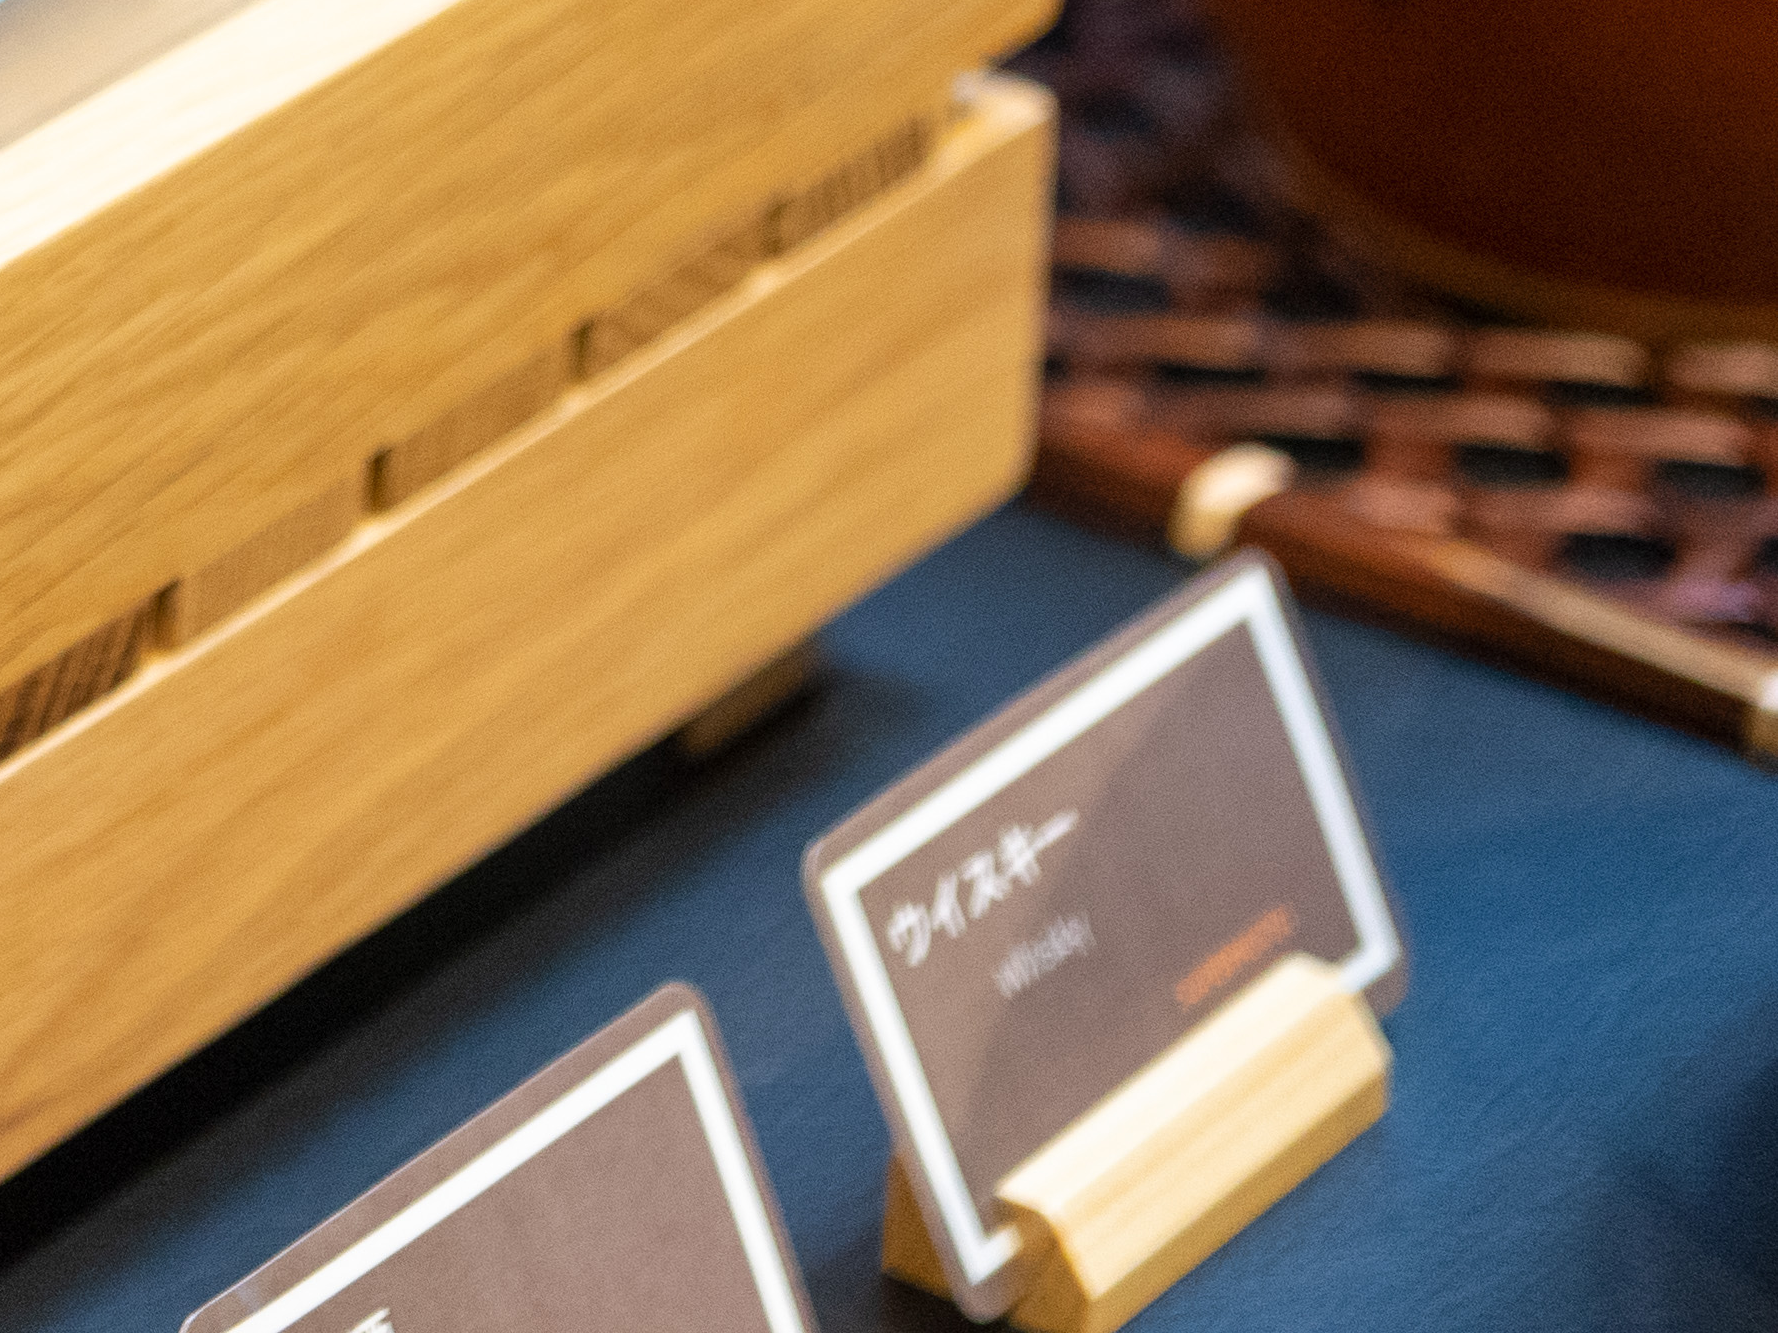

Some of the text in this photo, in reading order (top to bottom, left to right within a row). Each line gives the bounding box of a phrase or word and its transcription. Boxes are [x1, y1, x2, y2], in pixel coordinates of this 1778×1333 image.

[887, 807, 1080, 967] ウイスキー
